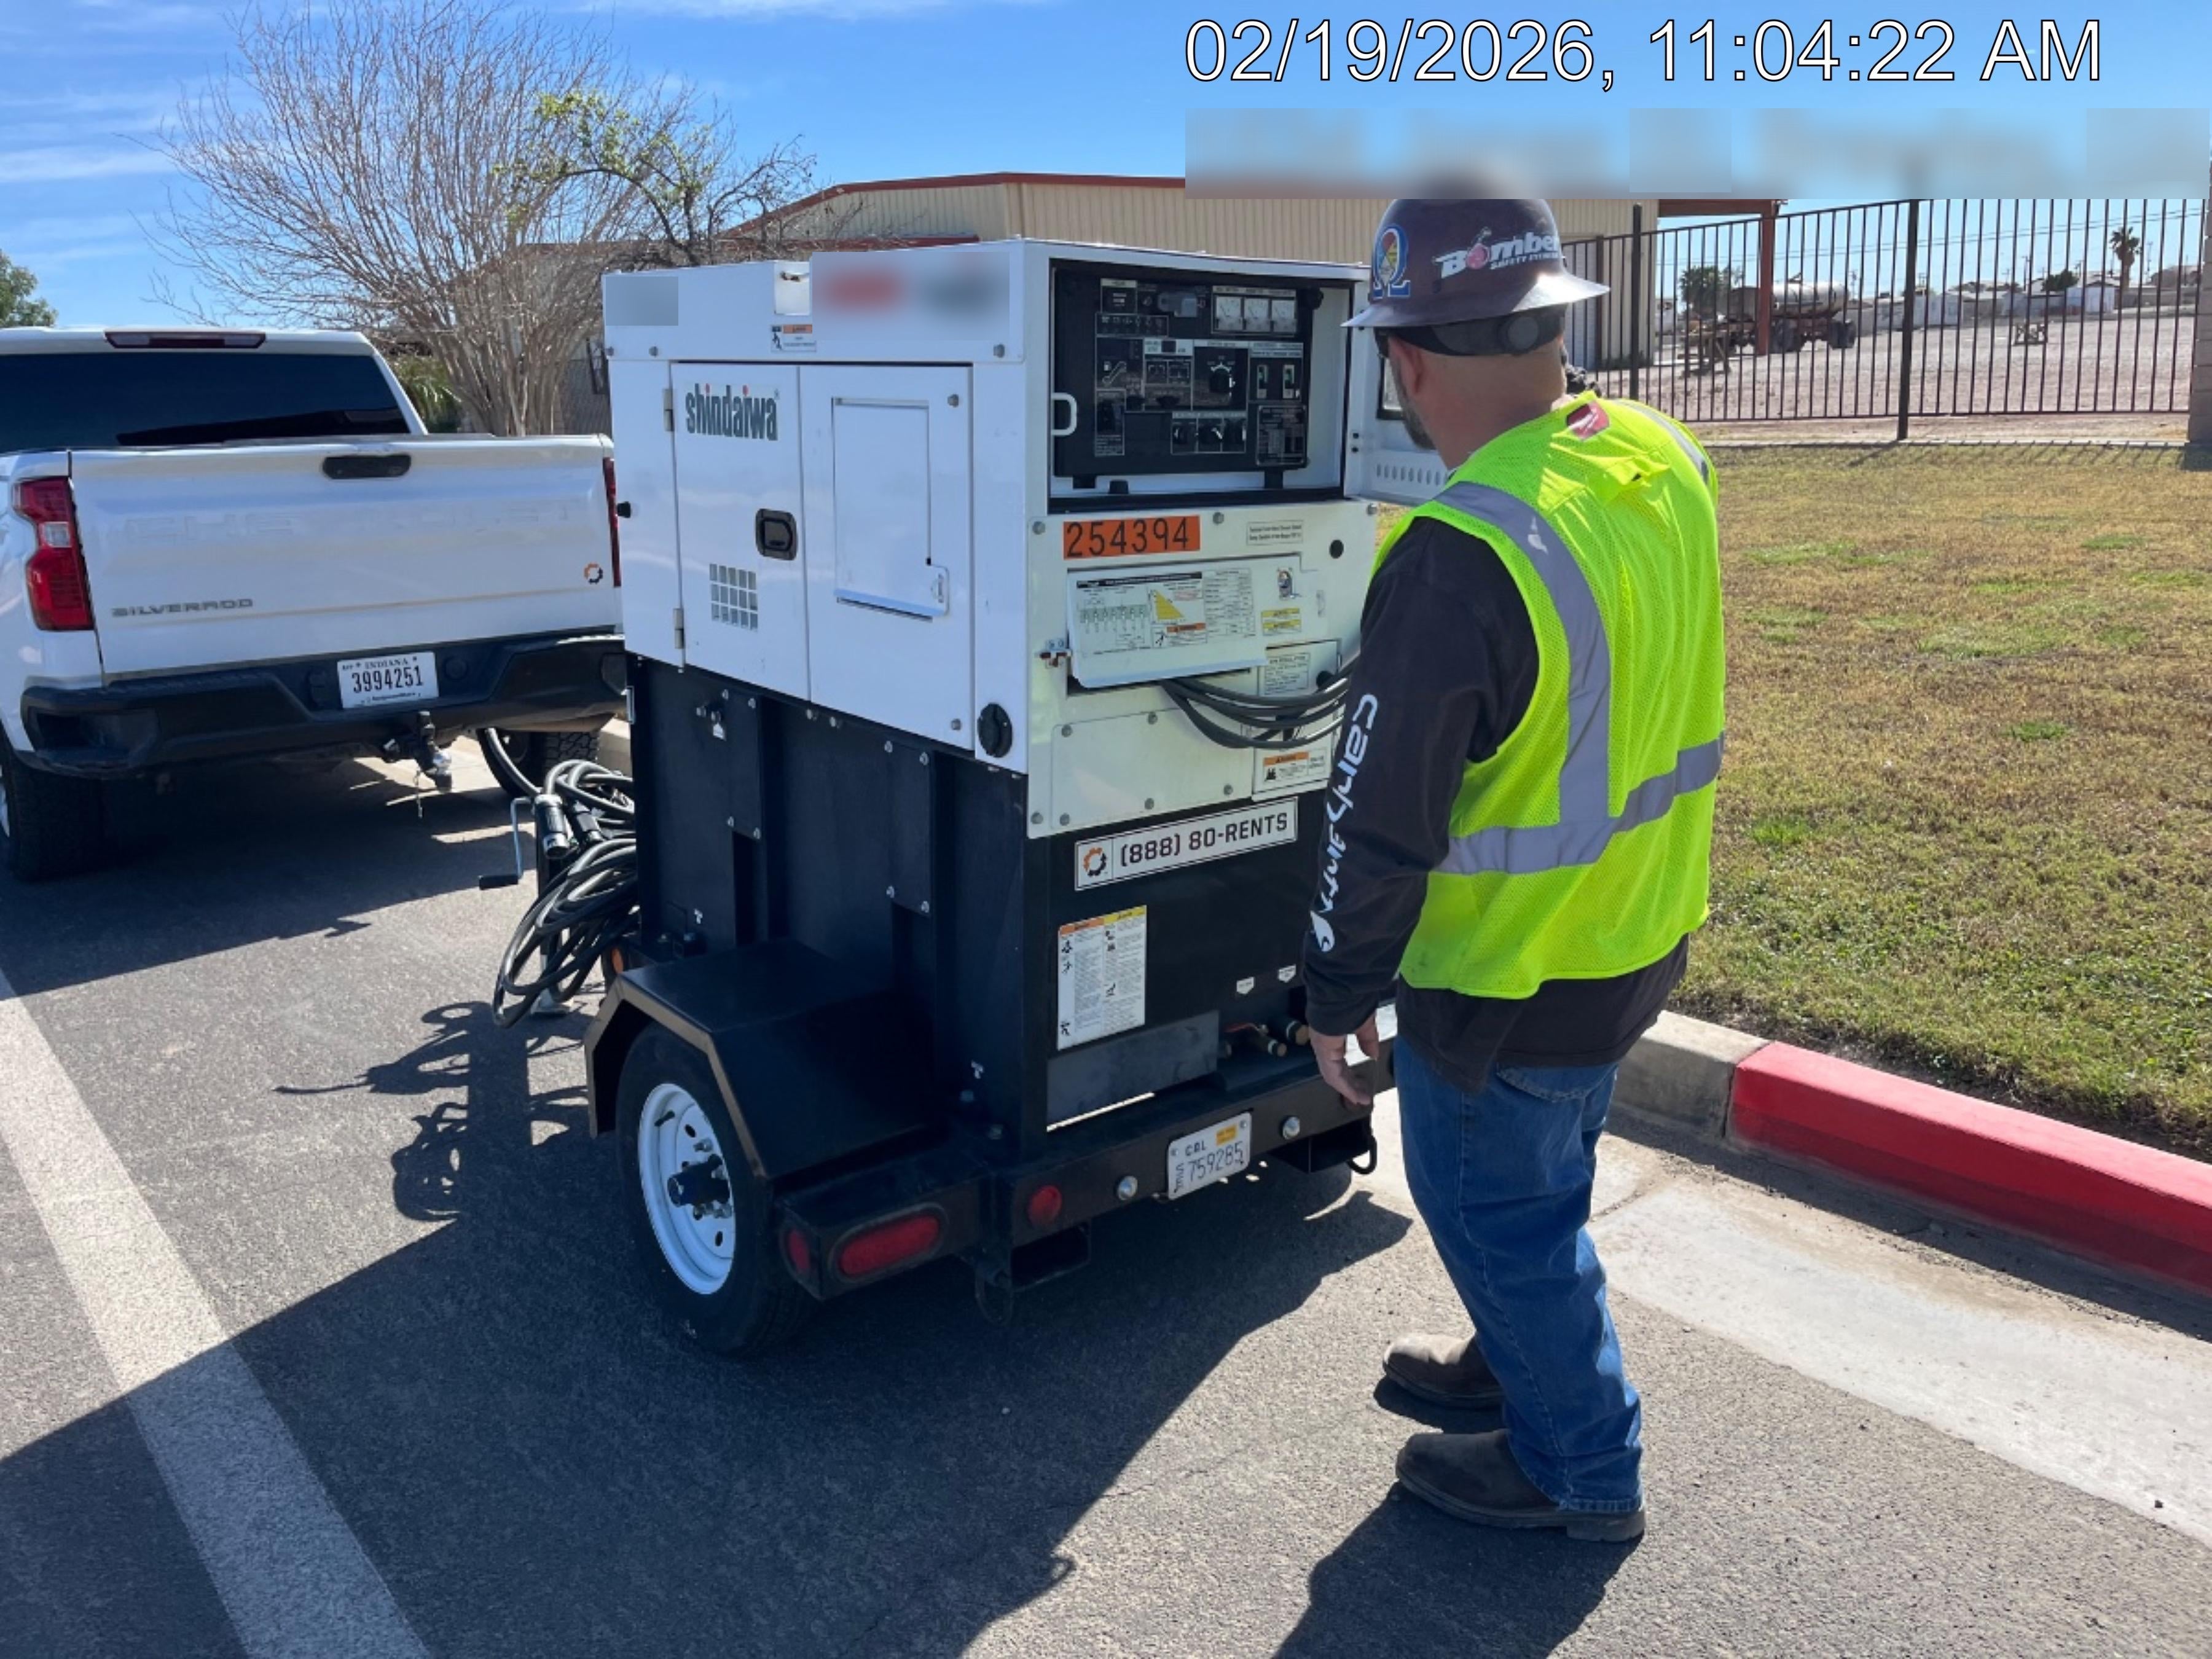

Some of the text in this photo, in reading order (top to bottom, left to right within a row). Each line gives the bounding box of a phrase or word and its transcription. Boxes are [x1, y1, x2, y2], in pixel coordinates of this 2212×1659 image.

[685, 383, 779, 441] shindaiwa
[1066, 517, 1189, 557] 254394
[351, 665, 423, 694] 3994251
[364, 658, 408, 670] INDIANA
[1120, 812, 1288, 866] (888) 80-RENTS
[1185, 1140, 1207, 1157] CAL
[1187, 1141, 1244, 1182] 759285
